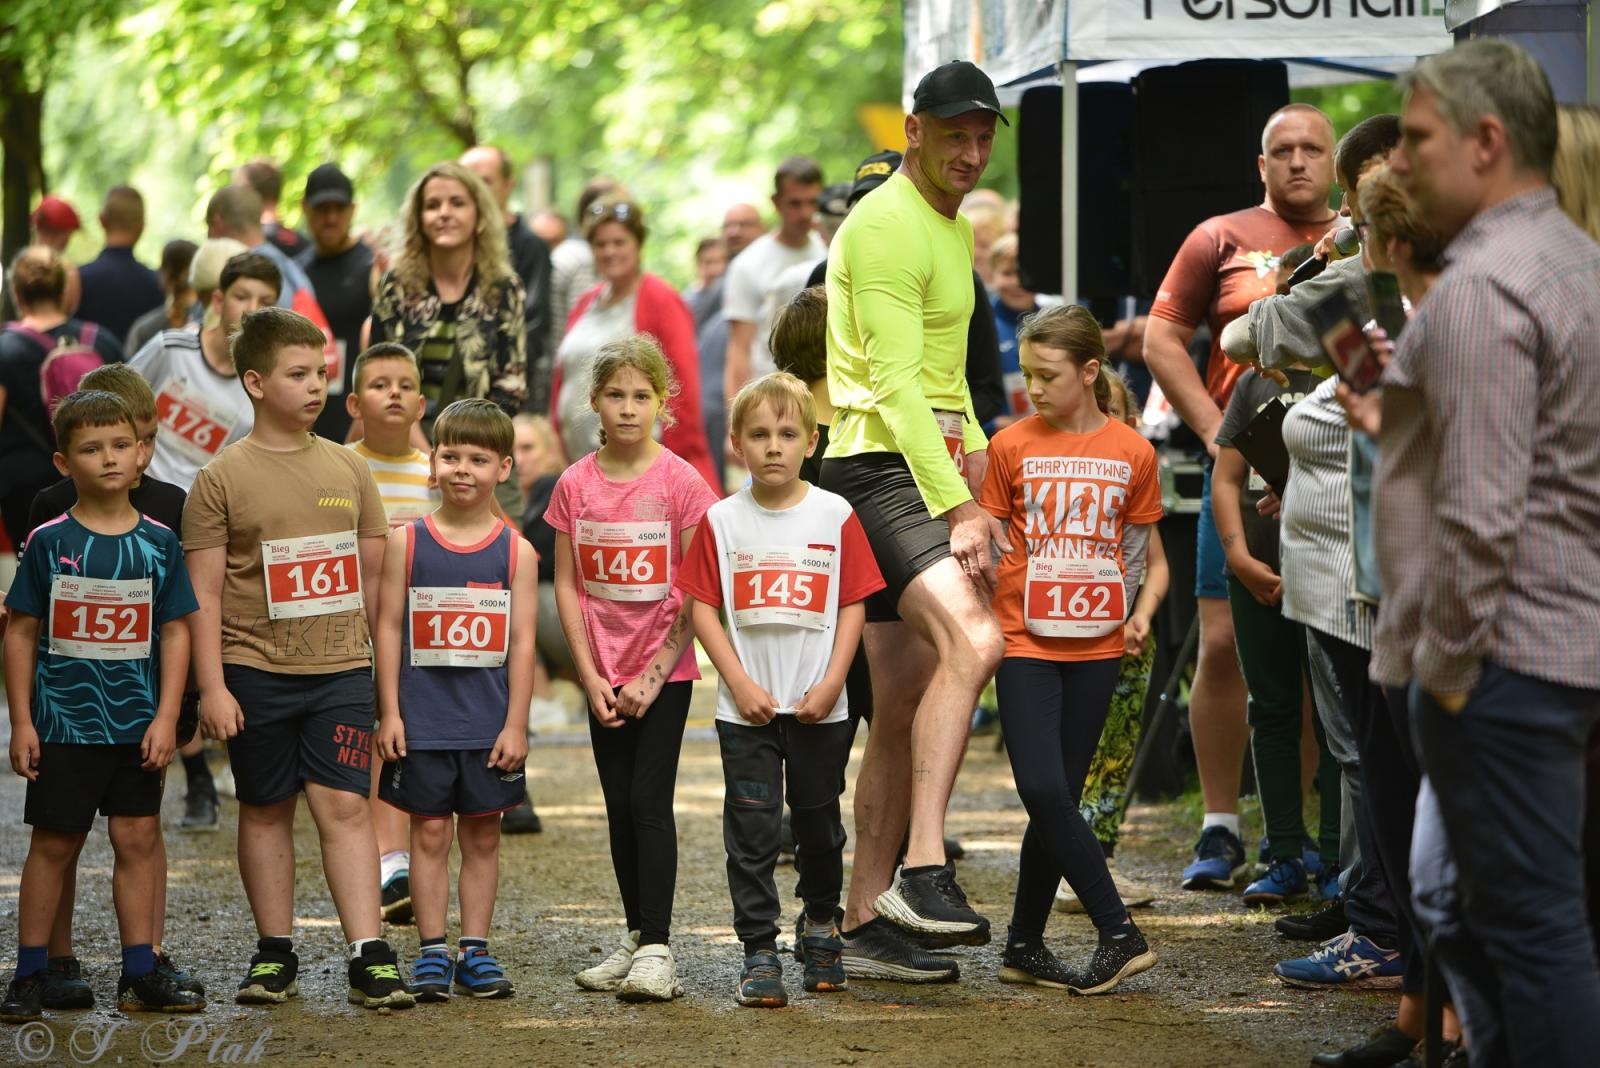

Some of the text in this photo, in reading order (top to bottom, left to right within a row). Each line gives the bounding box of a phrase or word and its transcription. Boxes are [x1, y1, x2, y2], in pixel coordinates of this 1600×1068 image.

[161, 403, 215, 445] 176
[1027, 460, 1129, 480] CHARYTATYWNE
[1023, 481, 1126, 539] KIDS
[659, 532, 666, 540] M
[271, 544, 290, 554] Bieg
[336, 542, 349, 551] 4500
[737, 553, 754, 562] Bieg
[591, 549, 654, 582] 146
[802, 559, 821, 568] 4500
[822, 561, 830, 569] M
[1035, 562, 1053, 572] Bieg
[1098, 569, 1113, 577] 4500
[287, 560, 349, 598] 161
[61, 581, 79, 592] Bieg
[748, 573, 813, 607] 145
[128, 591, 143, 599] 4500
[416, 592, 433, 602] Bieg
[479, 599, 498, 608] 4500
[499, 600, 506, 608] M
[1046, 585, 1111, 618] 162
[71, 605, 138, 640] 152
[427, 614, 492, 648] 160
